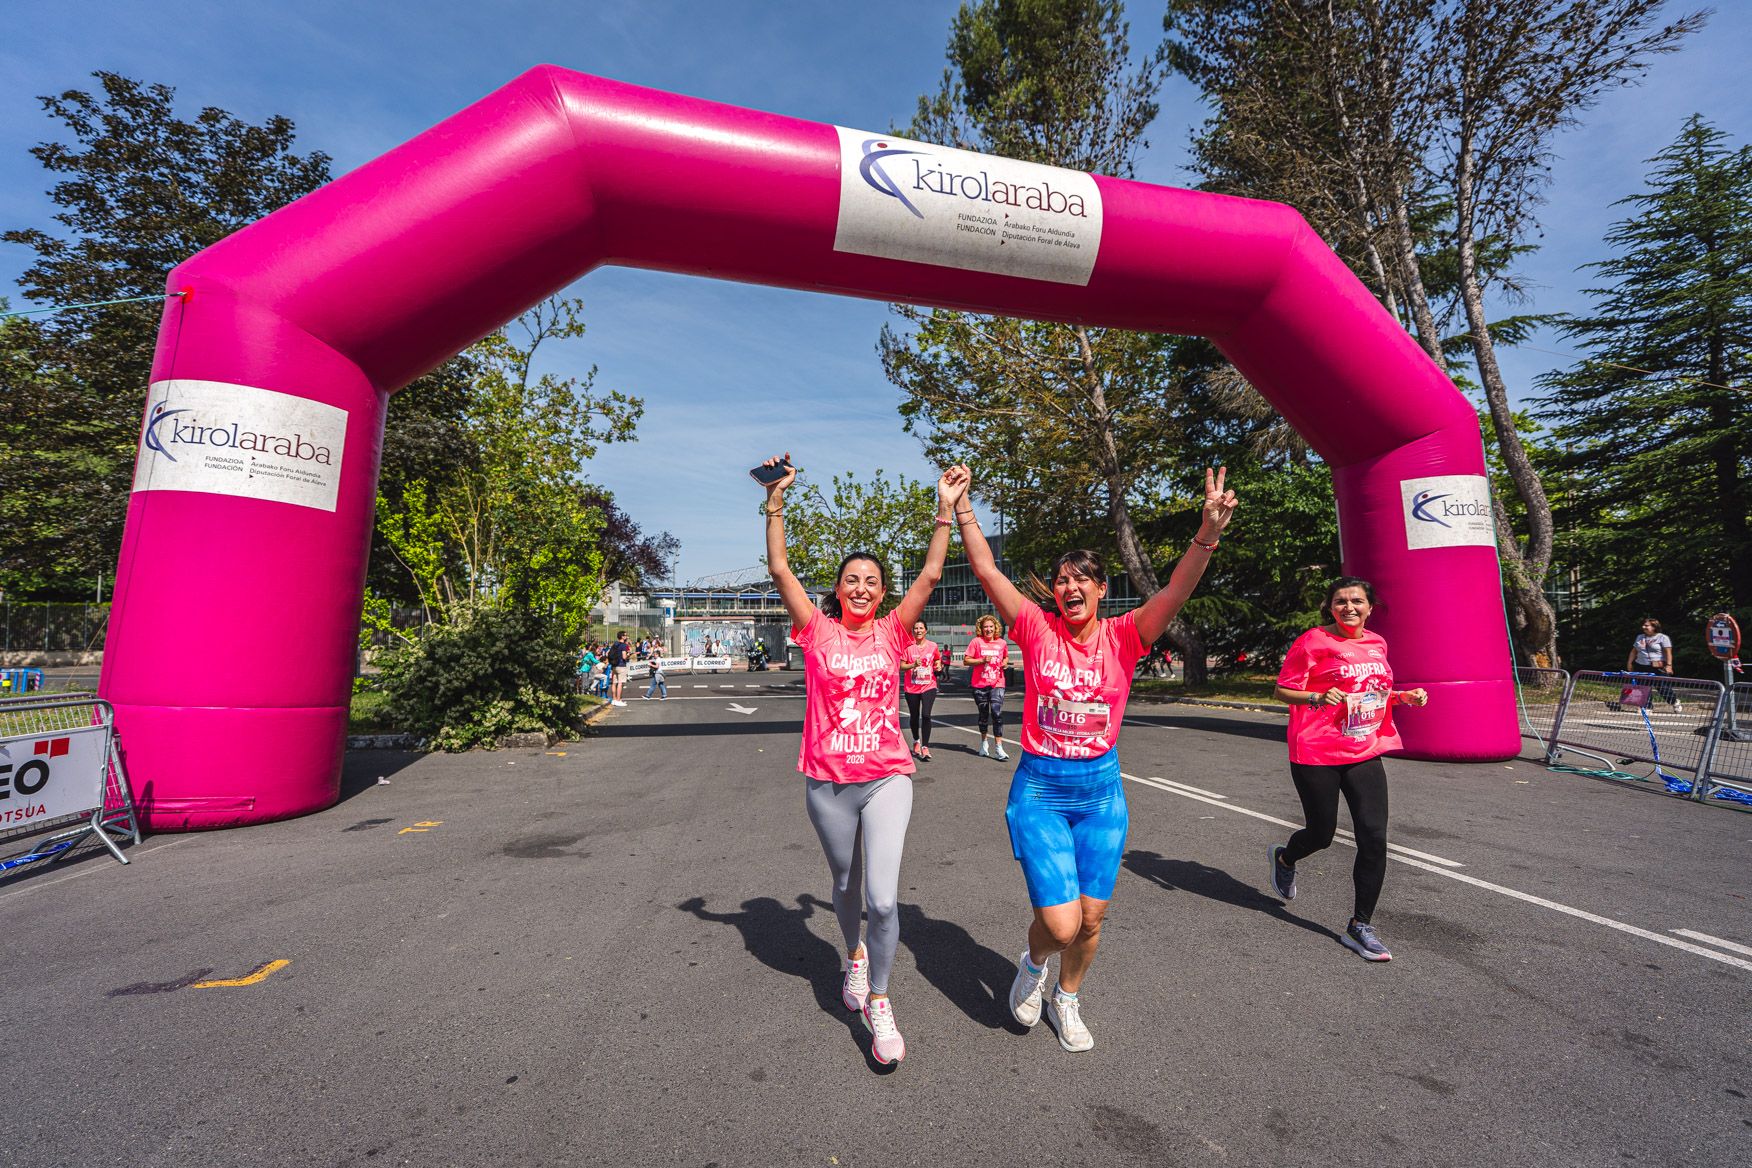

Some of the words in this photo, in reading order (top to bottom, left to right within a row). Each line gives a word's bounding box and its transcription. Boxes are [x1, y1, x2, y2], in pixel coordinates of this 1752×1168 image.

[911, 158, 1087, 218] kirolaraba
[956, 223, 996, 236] FUNDACIÓN
[1001, 230, 1036, 242] Diputación
[1037, 236, 1053, 245] Foral
[1054, 239, 1062, 247] de
[958, 213, 998, 226] FUNDAZIOA
[1004, 221, 1031, 232] Arabako
[1032, 225, 1047, 234] Foru
[1047, 227, 1075, 239] Aldundia
[170, 418, 332, 466] kirolaraba
[205, 455, 244, 465] FUNDAZIOA
[251, 461, 278, 471] Arabako
[279, 465, 294, 473] Foru
[1441, 499, 1491, 517] kirolar
[635, 663, 649, 671] CORRE
[1041, 660, 1102, 687] CARERA
[1340, 662, 1388, 678] CARRERA
[831, 733, 880, 753] MUJER
[0, 804, 46, 823] TSUA
